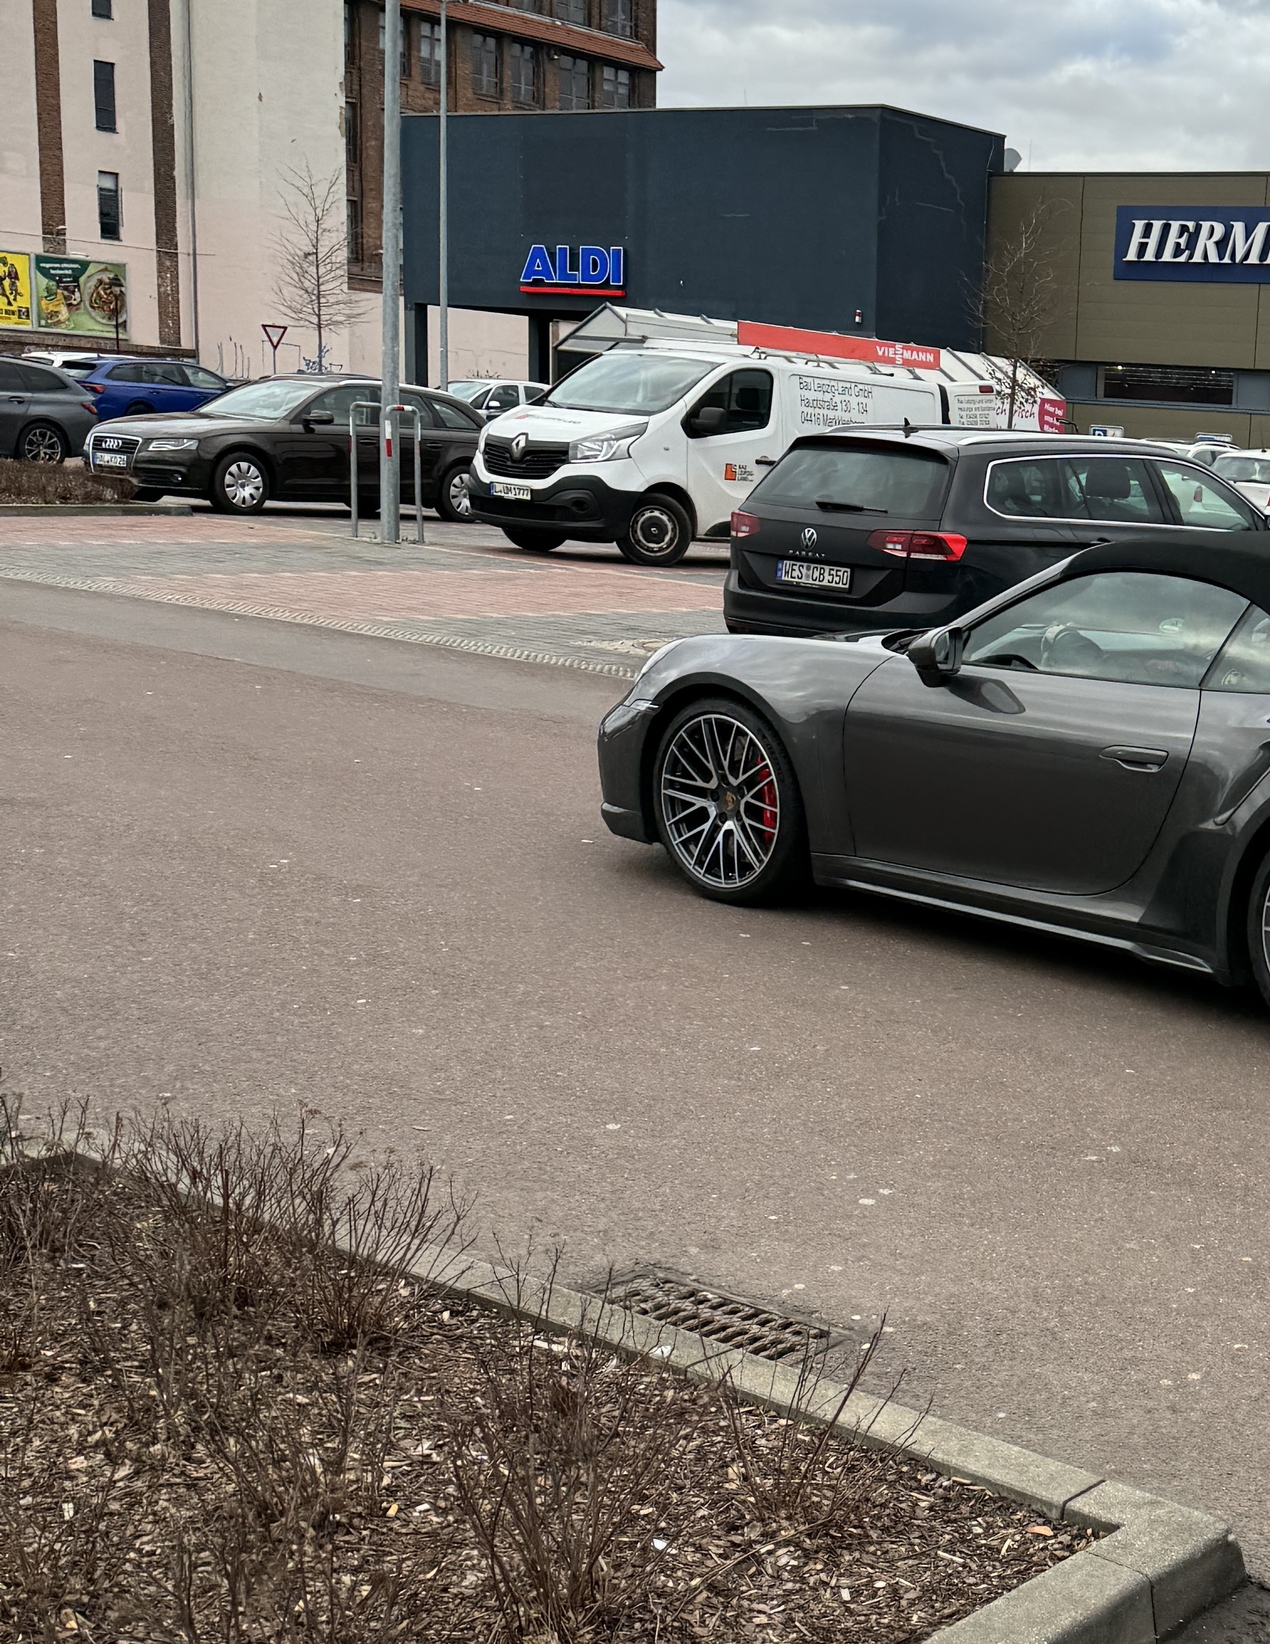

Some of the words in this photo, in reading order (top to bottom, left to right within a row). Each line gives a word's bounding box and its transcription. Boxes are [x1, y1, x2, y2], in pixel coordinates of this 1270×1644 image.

[520, 244, 624, 286] ALDI
[798, 376, 812, 391] Bau
[853, 384, 873, 399] GmbH
[800, 394, 839, 412] Hauptstraße
[857, 402, 868, 415] 134
[783, 562, 804, 580] WES
[811, 566, 826, 583] CB
[827, 568, 849, 586] 550
